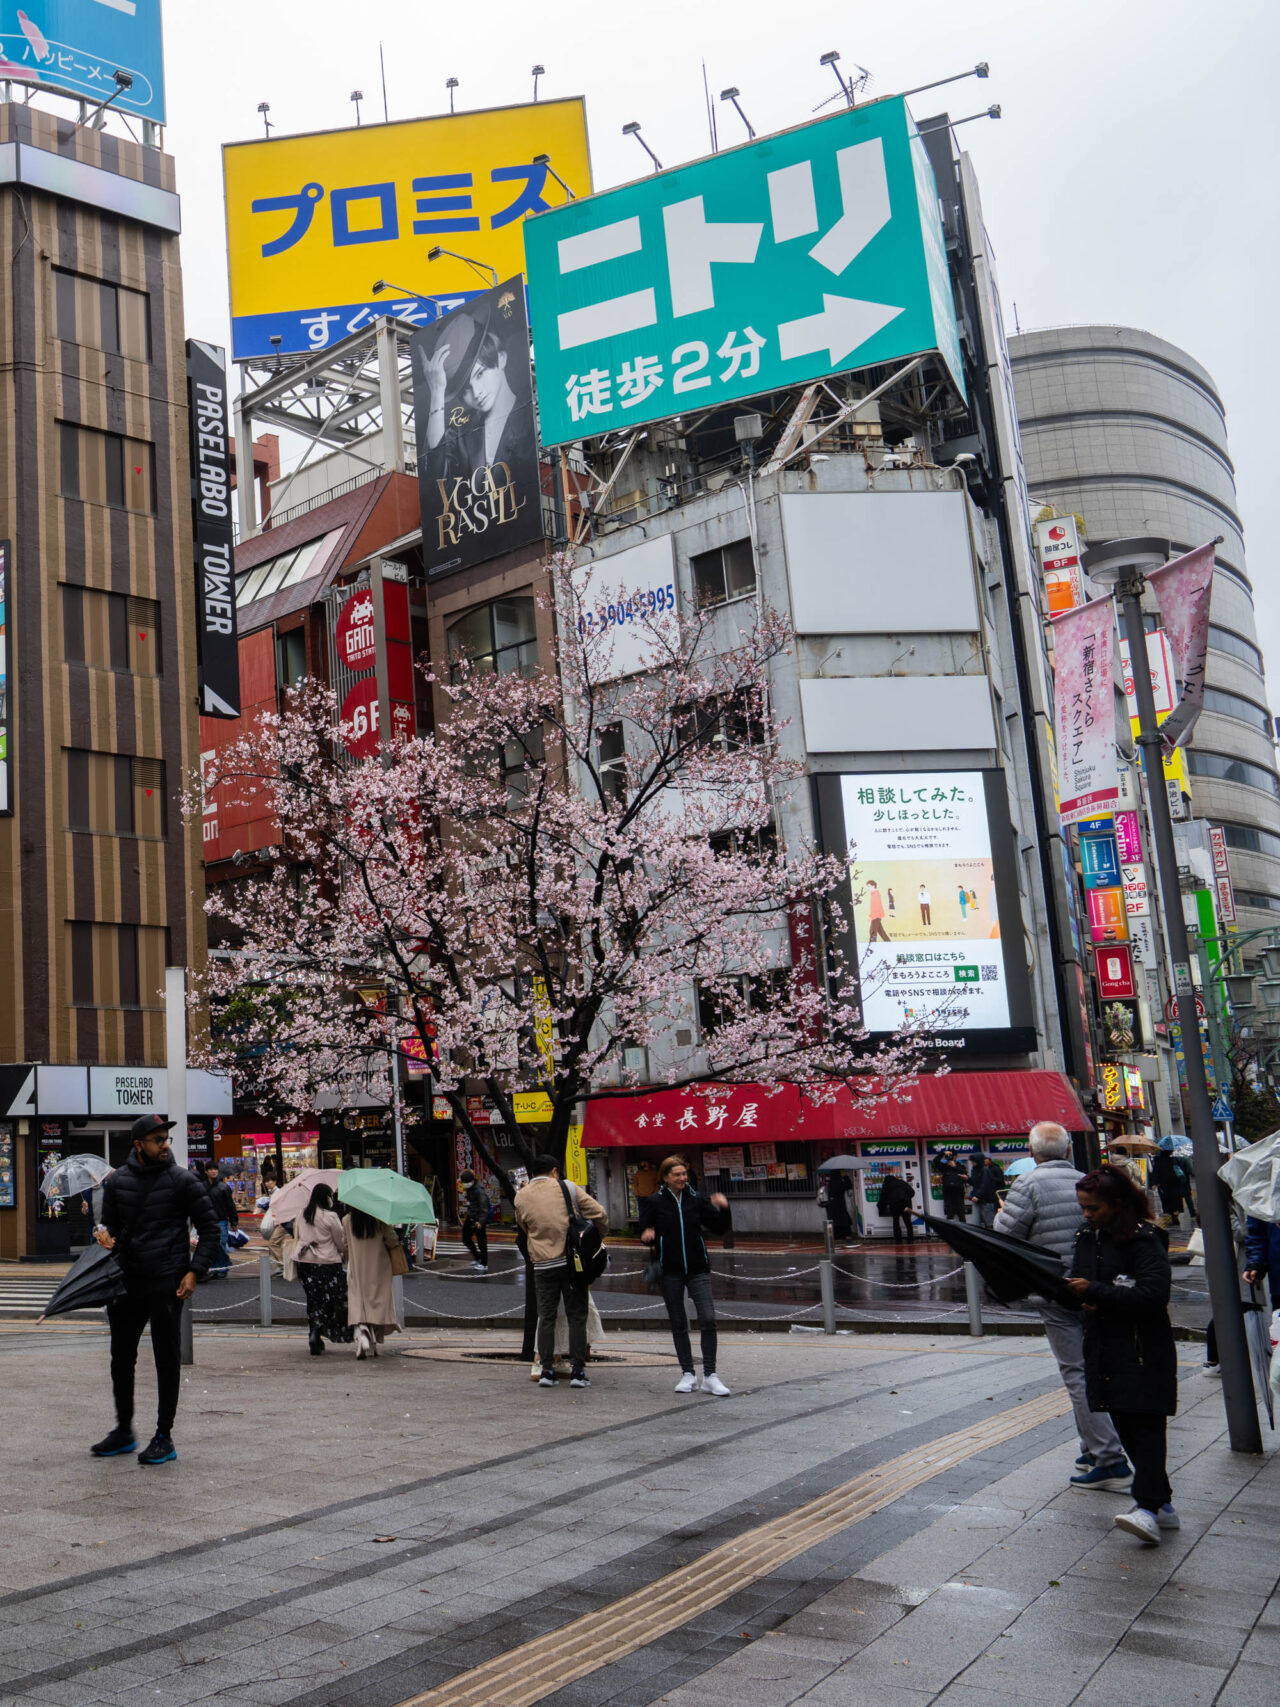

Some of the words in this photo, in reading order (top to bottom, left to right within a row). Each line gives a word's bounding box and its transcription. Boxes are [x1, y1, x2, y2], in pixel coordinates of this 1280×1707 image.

[251, 163, 552, 258] プロミス
[557, 136, 892, 351] ニトリ
[196, 382, 228, 518] PASELABO
[1053, 559, 1068, 567] 9F
[202, 543, 233, 635] TOWER
[345, 625, 375, 654] GAM
[347, 651, 361, 662] TAITO
[1074, 774, 1091, 783] Sakura
[857, 785, 974, 806] 相談してみた。
[873, 808, 960, 822] 少しほっとした。
[1089, 820, 1102, 829] 4F
[1115, 814, 1129, 862] Serina
[1213, 833, 1225, 867] カラオケ
[1130, 853, 1141, 863] 3F
[1126, 903, 1144, 913] 2F
[1186, 925, 1198, 933] 4F
[896, 951, 966, 963] 相談窓口はこちら
[892, 970, 950, 980] まもろうよこころ
[959, 968, 976, 979] 検索
[1101, 979, 1117, 988] Gong
[1118, 979, 1131, 987] cha
[935, 1036, 966, 1048] Board
[115, 1076, 154, 1088] PASELABO
[1103, 1066, 1121, 1107] ラーメン
[116, 1089, 154, 1105] TOWER
[634, 1112, 667, 1129] 食堂
[675, 1102, 759, 1131] 長野屋
[879, 1145, 896, 1153] ITO
[896, 1144, 908, 1153] EN
[945, 1143, 961, 1151] ITO
[961, 1143, 974, 1151] EN
